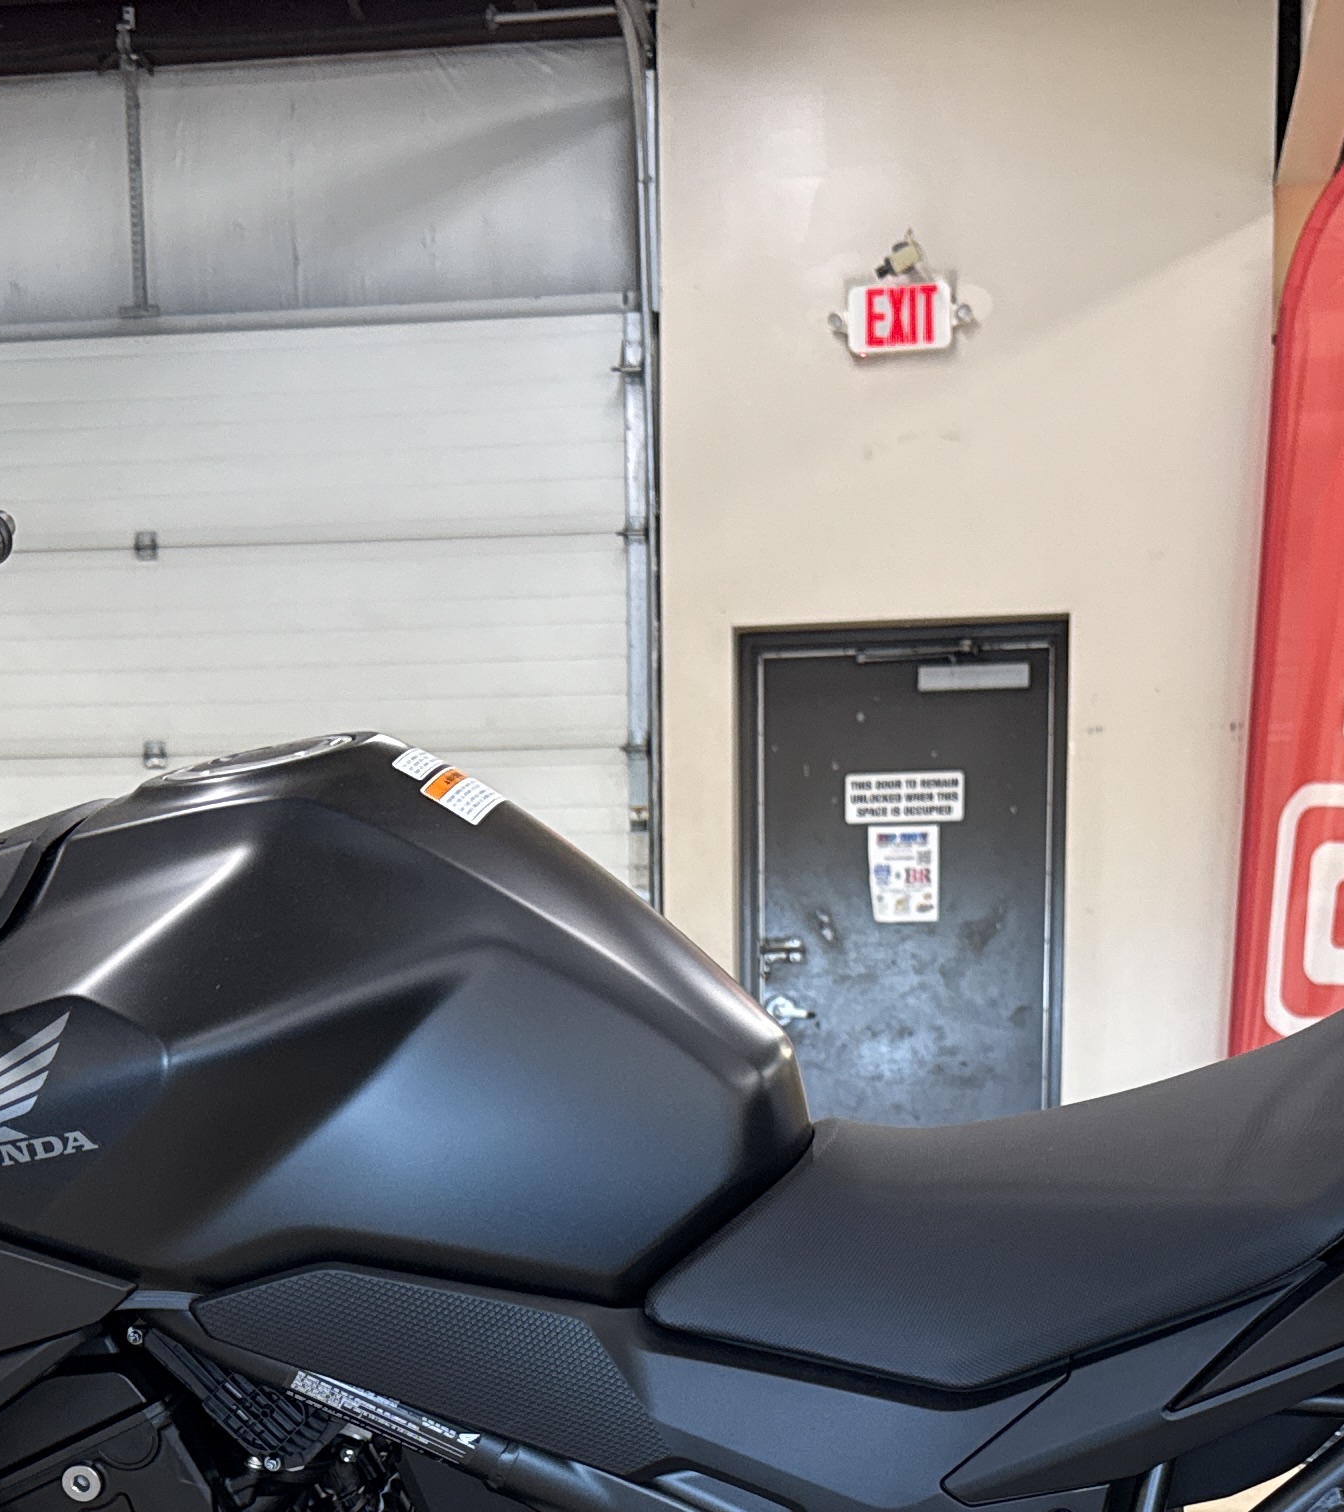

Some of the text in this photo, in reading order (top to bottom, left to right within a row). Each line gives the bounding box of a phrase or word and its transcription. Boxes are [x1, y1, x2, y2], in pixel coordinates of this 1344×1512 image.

[865, 284, 939, 347] EXIT
[851, 777, 959, 791] THIS DOOR TO REMAIN
[850, 791, 958, 804] UNLOCKED WHEN THIS
[857, 805, 953, 818] SPACE IS OCCUPIED
